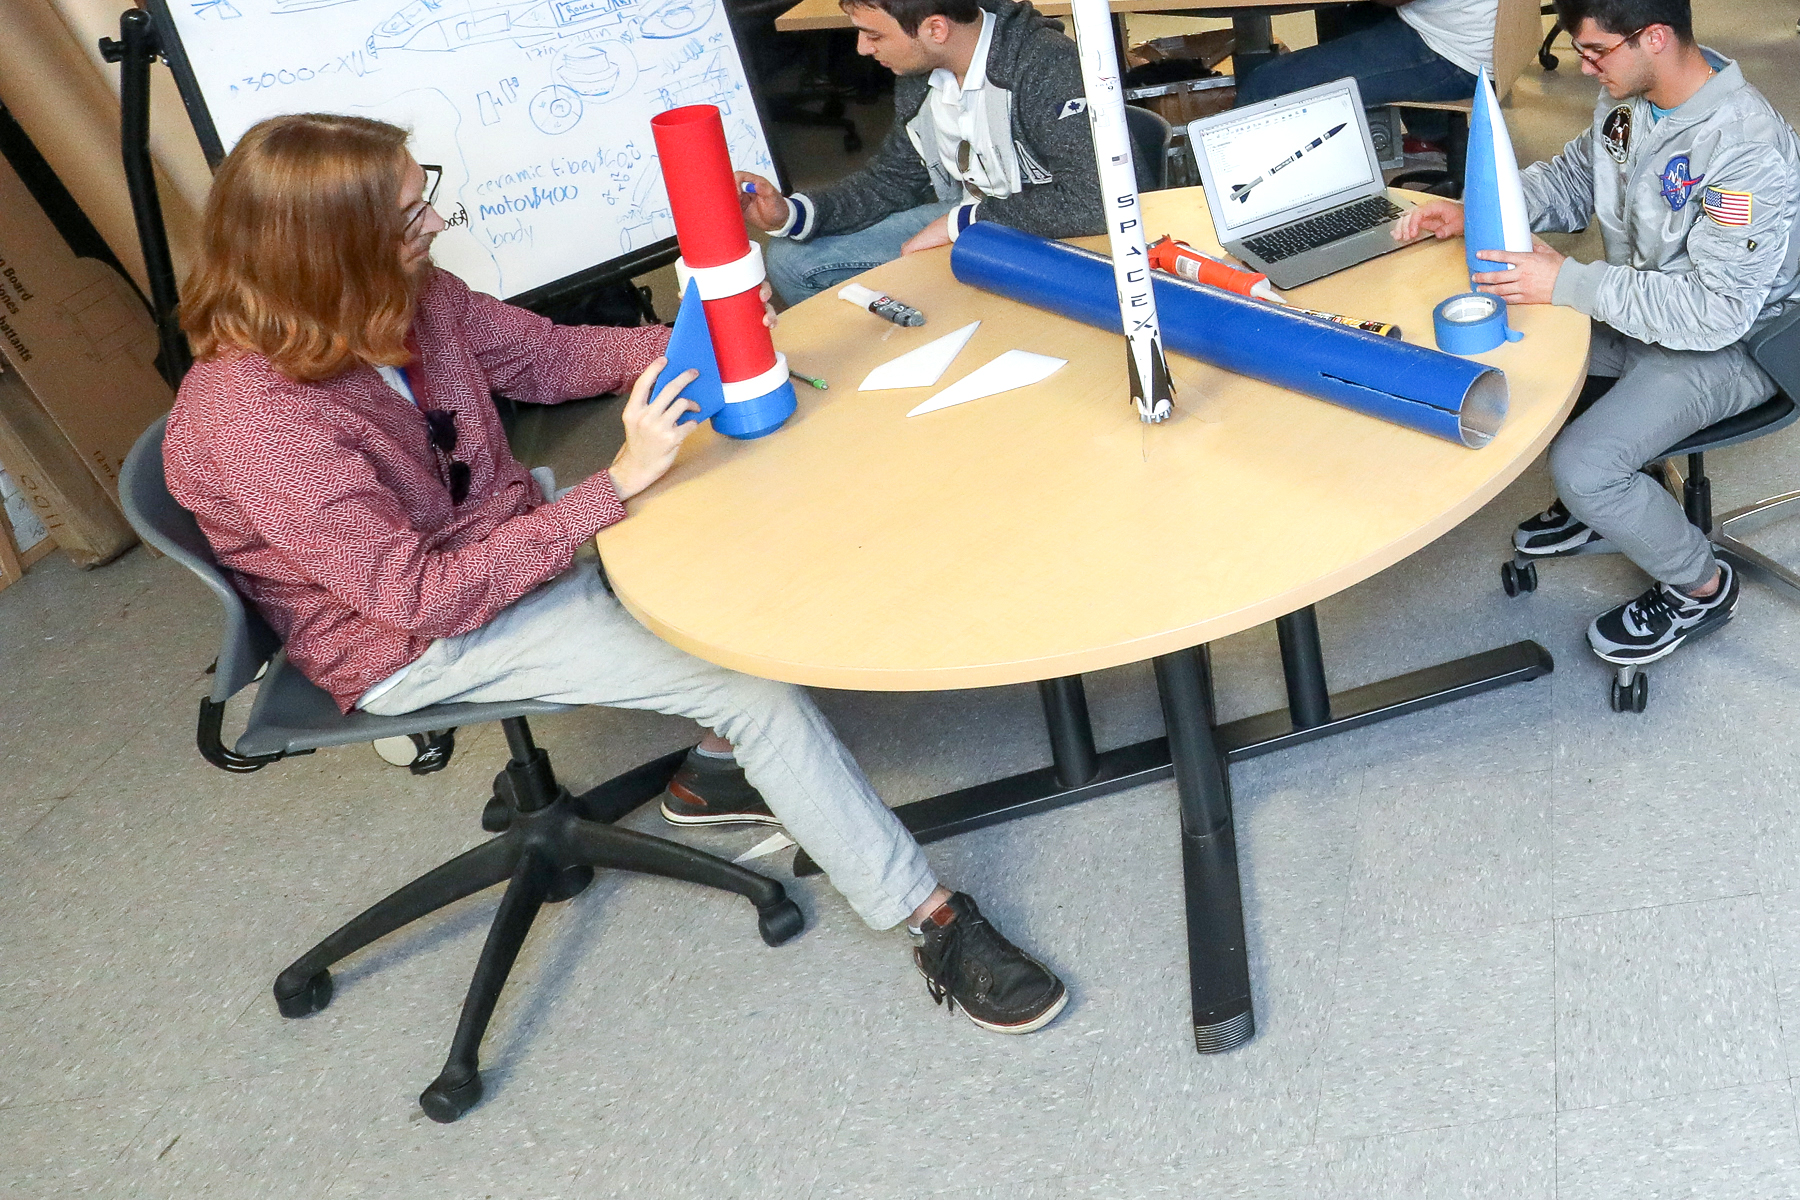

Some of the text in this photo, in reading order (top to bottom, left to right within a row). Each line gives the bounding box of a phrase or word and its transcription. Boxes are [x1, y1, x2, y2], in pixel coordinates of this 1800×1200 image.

[476, 163, 547, 196] ceramic
[1117, 193, 1156, 332] SPACEX
[3, 267, 34, 302] Board
